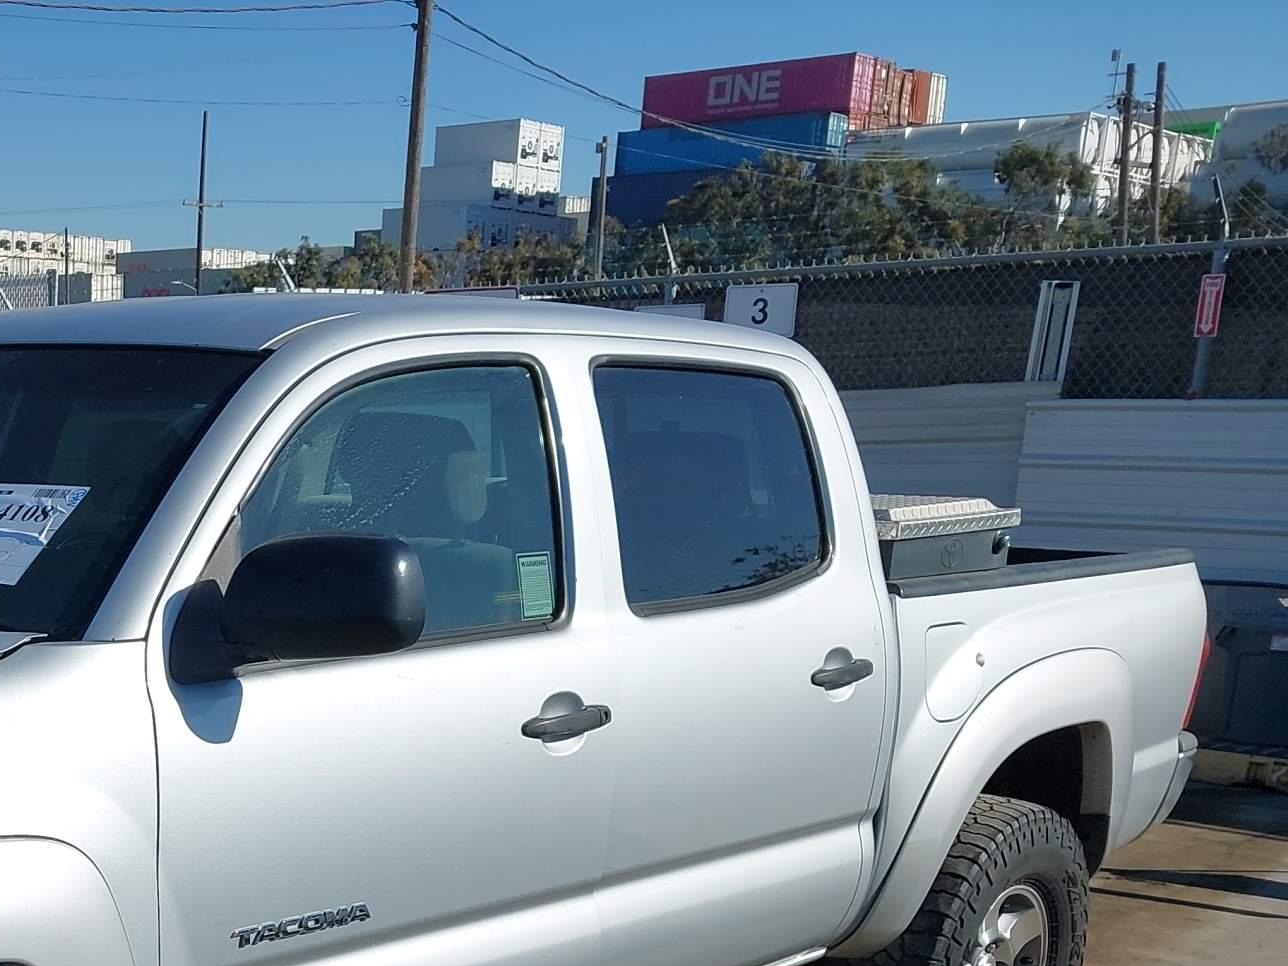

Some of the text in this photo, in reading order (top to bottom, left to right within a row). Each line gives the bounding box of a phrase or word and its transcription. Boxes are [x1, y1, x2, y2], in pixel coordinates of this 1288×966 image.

[708, 70, 782, 105] ONE
[751, 297, 768, 325] 3
[520, 559, 547, 568] WARNING
[229, 901, 372, 949] TACOMA
